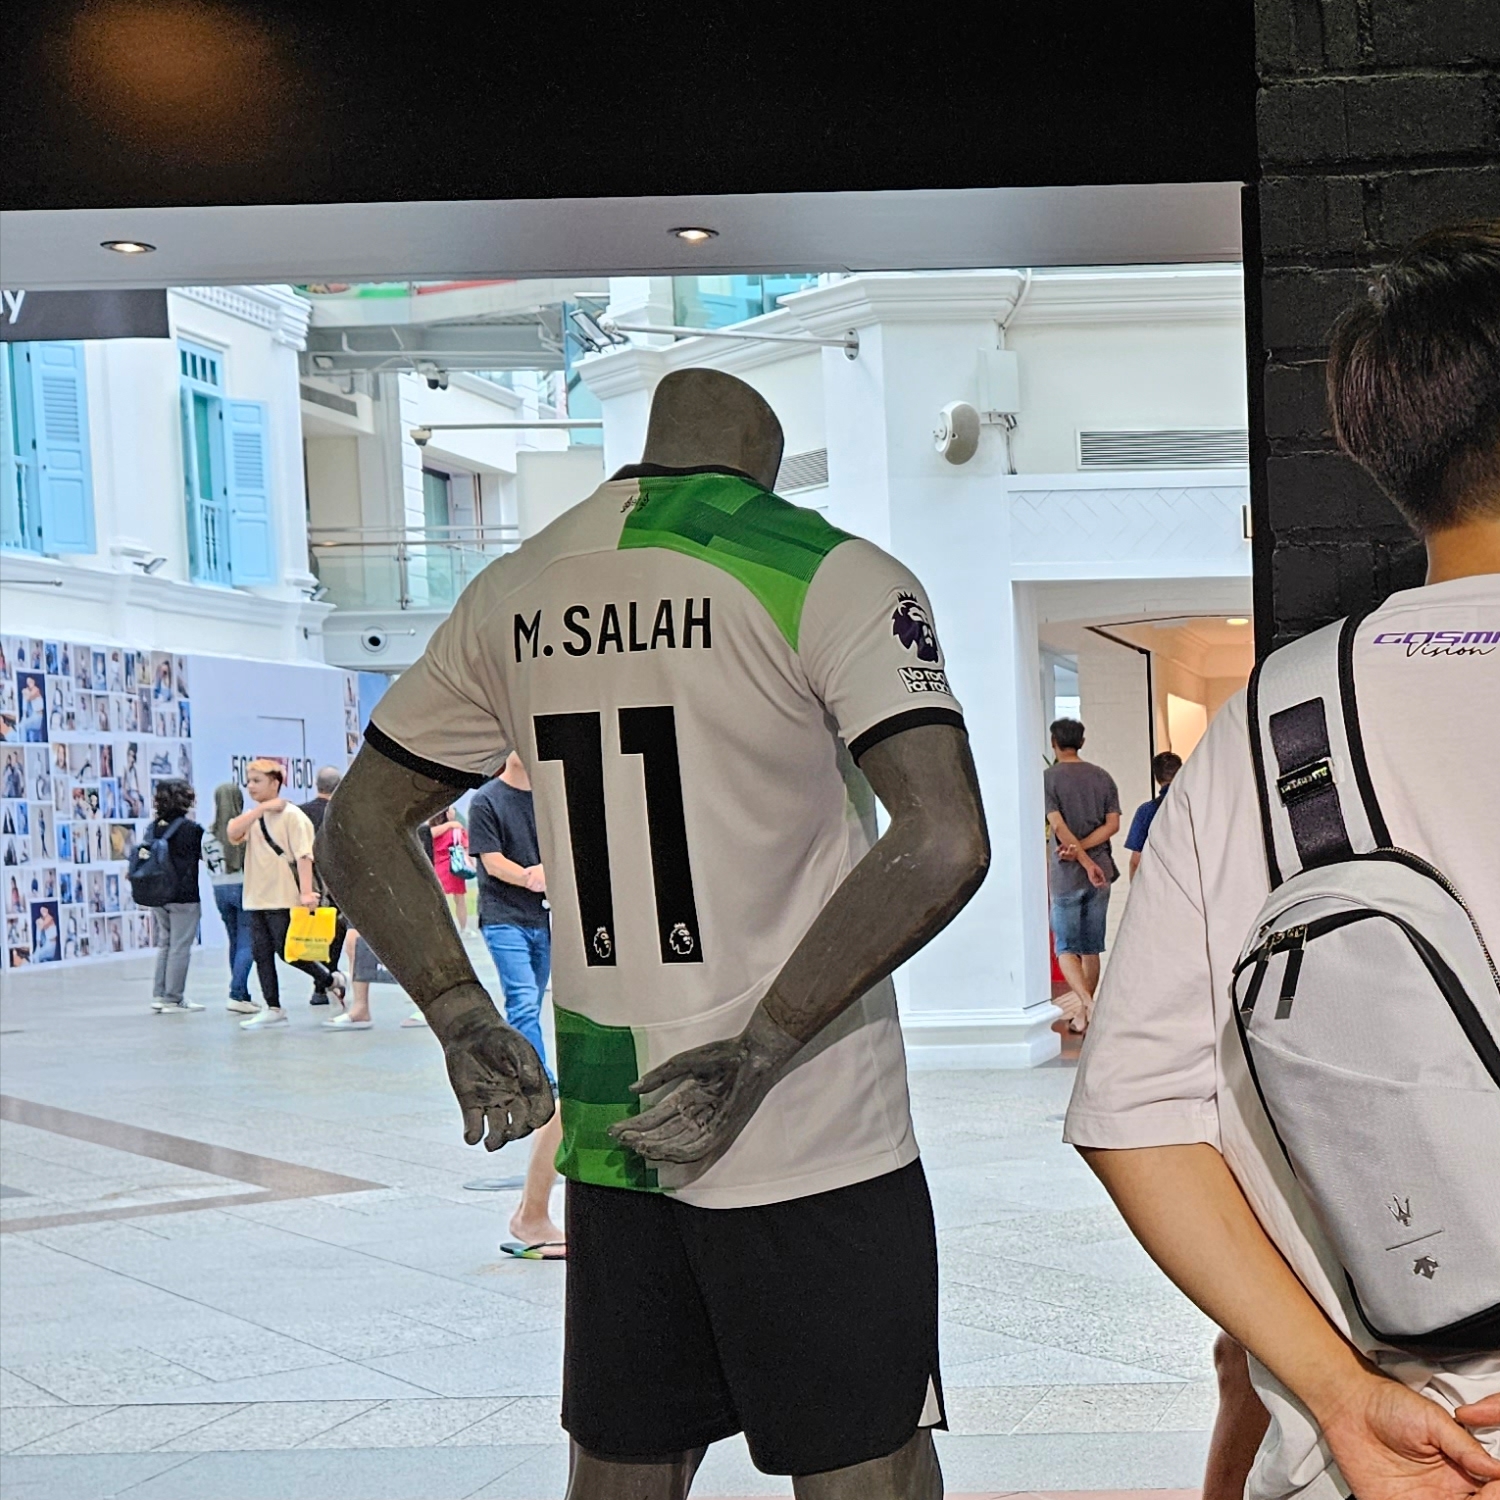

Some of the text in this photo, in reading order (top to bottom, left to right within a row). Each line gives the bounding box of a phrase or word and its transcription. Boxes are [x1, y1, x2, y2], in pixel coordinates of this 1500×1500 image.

[1406, 637, 1497, 658] Vision
[899, 667, 924, 681] No
[532, 705, 704, 967] 11
